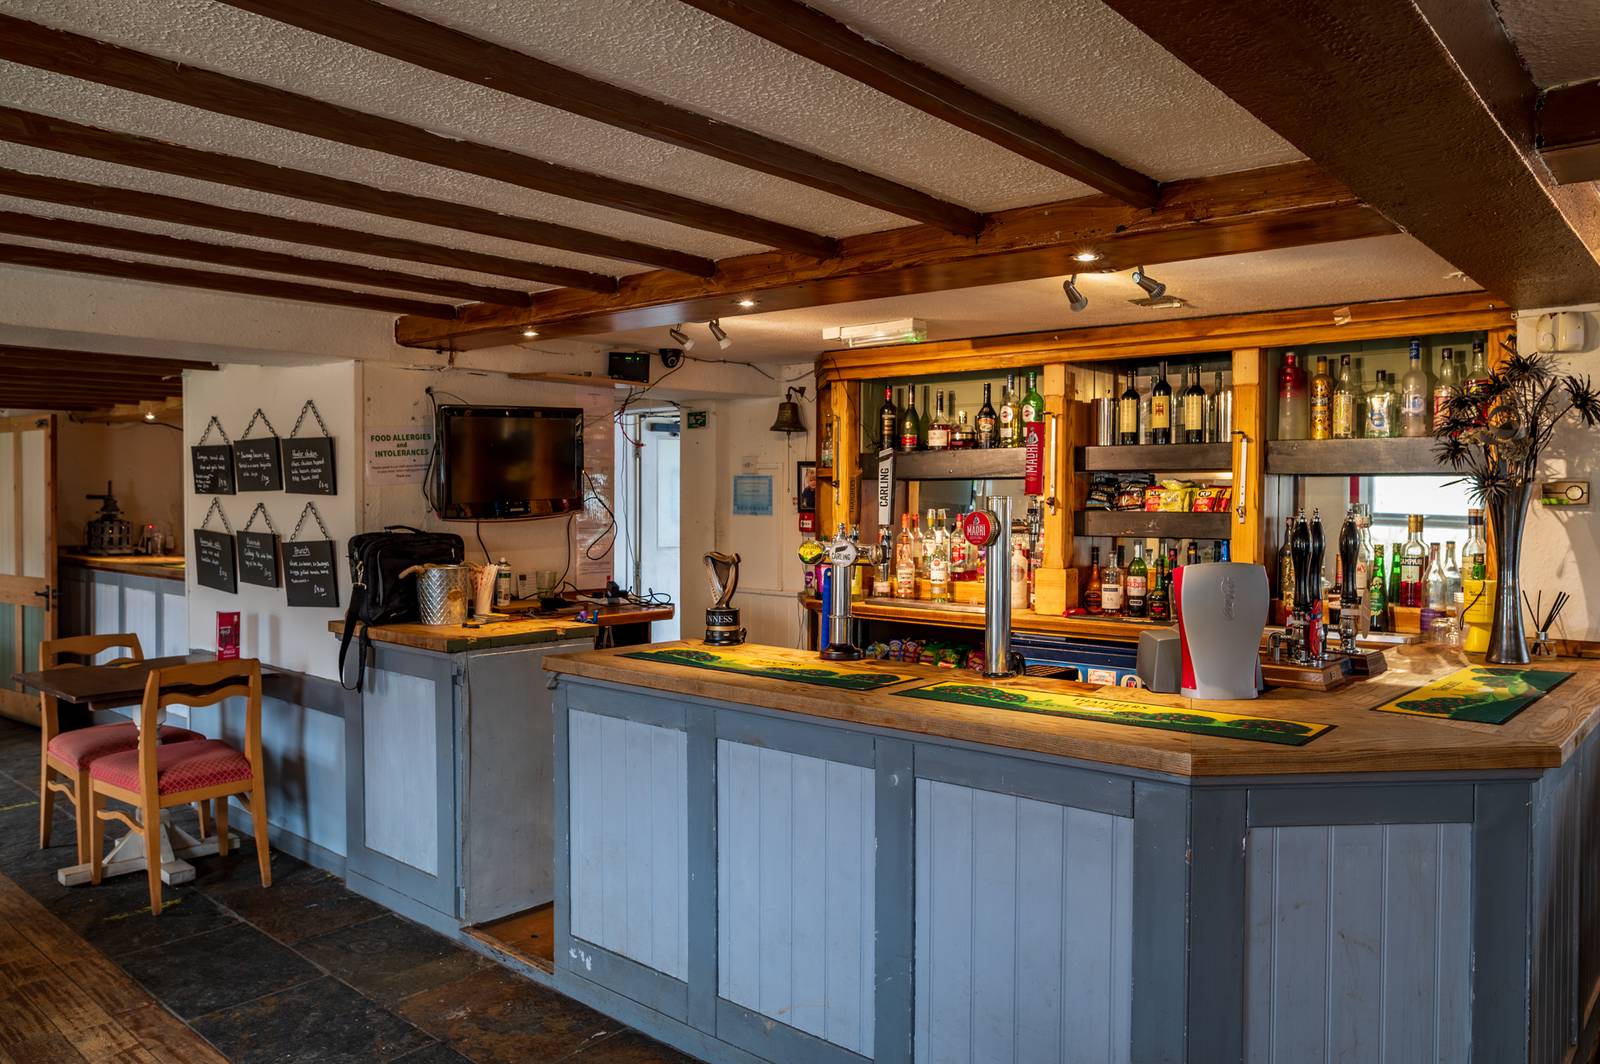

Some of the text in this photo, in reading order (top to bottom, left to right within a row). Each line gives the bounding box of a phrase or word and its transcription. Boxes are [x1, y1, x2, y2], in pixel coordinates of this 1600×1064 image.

[393, 433, 432, 441] ALLERGIES
[375, 449, 429, 457] INTOLERANCES
[880, 467, 889, 507] CARLING
[832, 552, 851, 561] CARLING
